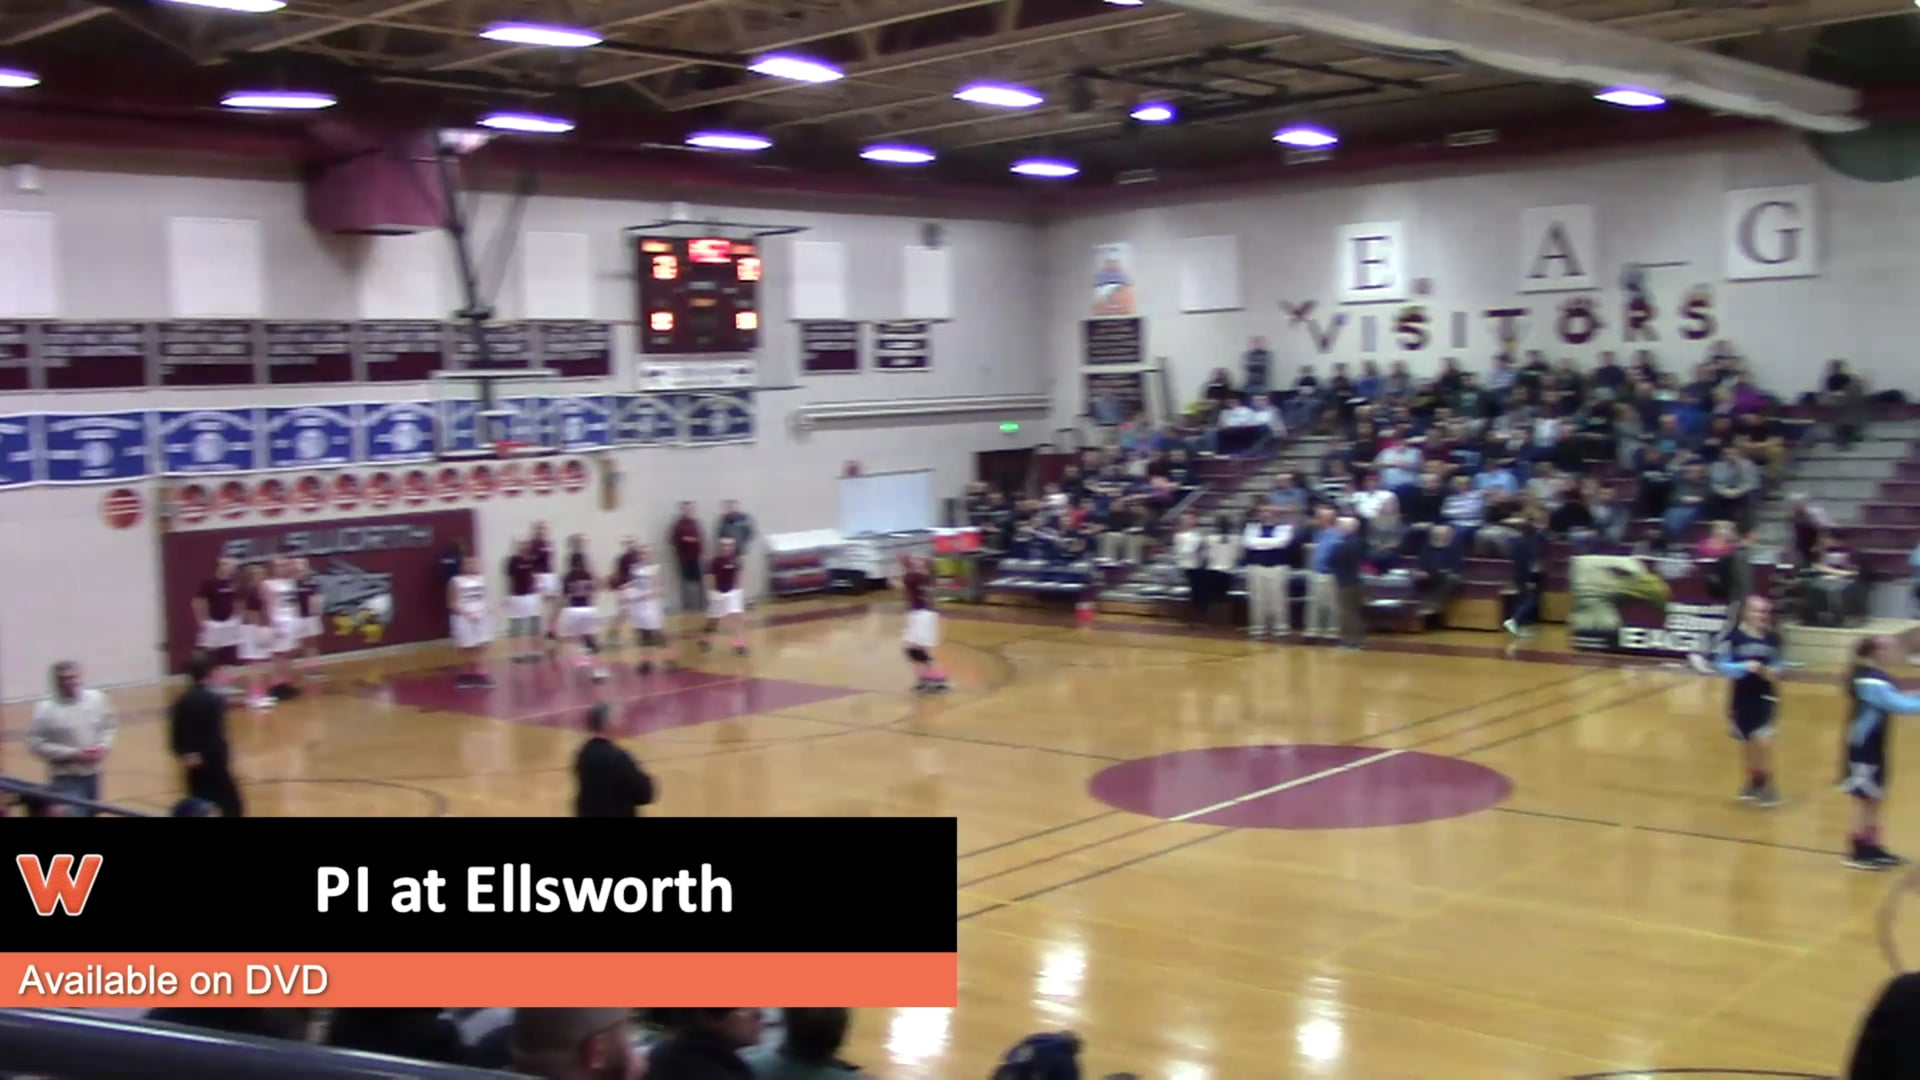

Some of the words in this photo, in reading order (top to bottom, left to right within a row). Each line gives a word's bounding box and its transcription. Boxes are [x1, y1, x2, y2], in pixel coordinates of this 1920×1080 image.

[1348, 235, 1394, 290] E
[1526, 218, 1586, 280] A
[1736, 200, 1803, 264] G
[1305, 290, 1718, 353] VISITORS
